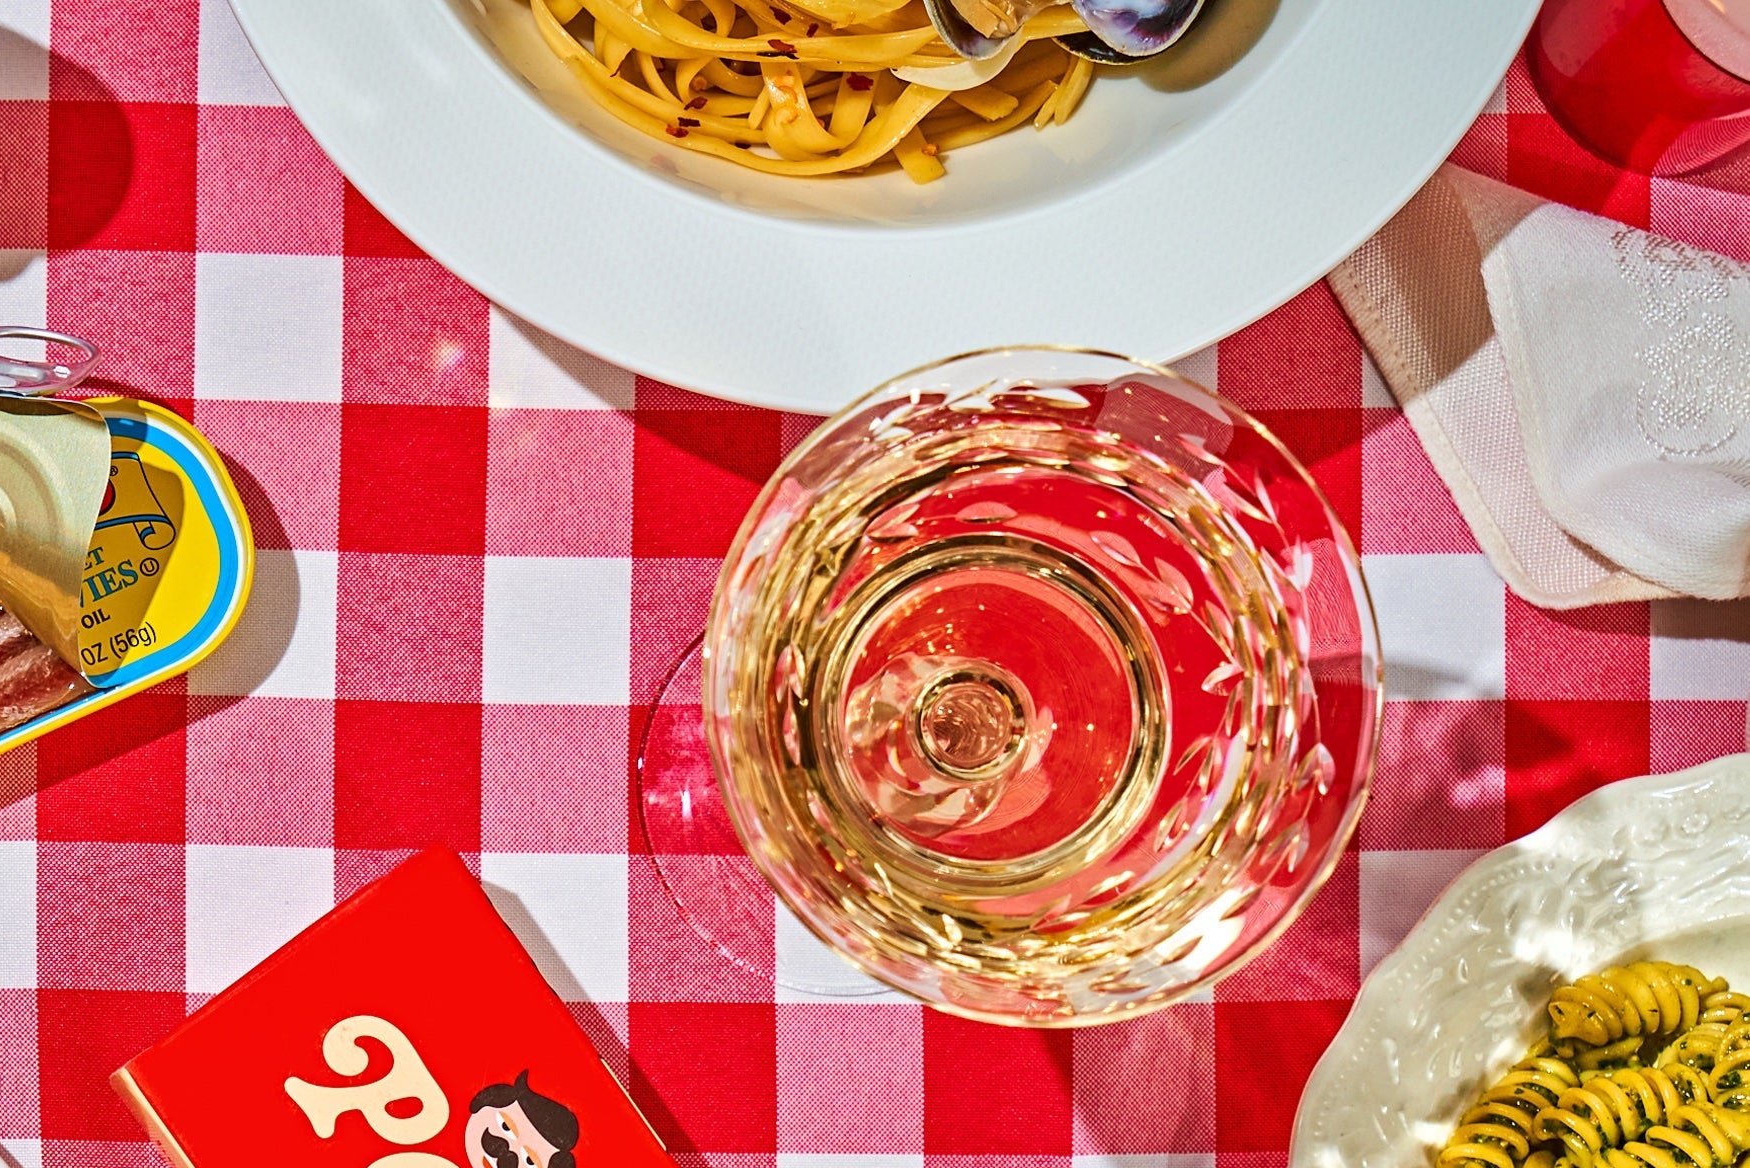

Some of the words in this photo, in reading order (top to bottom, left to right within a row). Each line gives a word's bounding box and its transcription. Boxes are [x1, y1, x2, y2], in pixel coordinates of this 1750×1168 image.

[81, 608, 111, 629] OIL
[81, 642, 109, 666] OZ
[109, 622, 157, 658] (56g)
